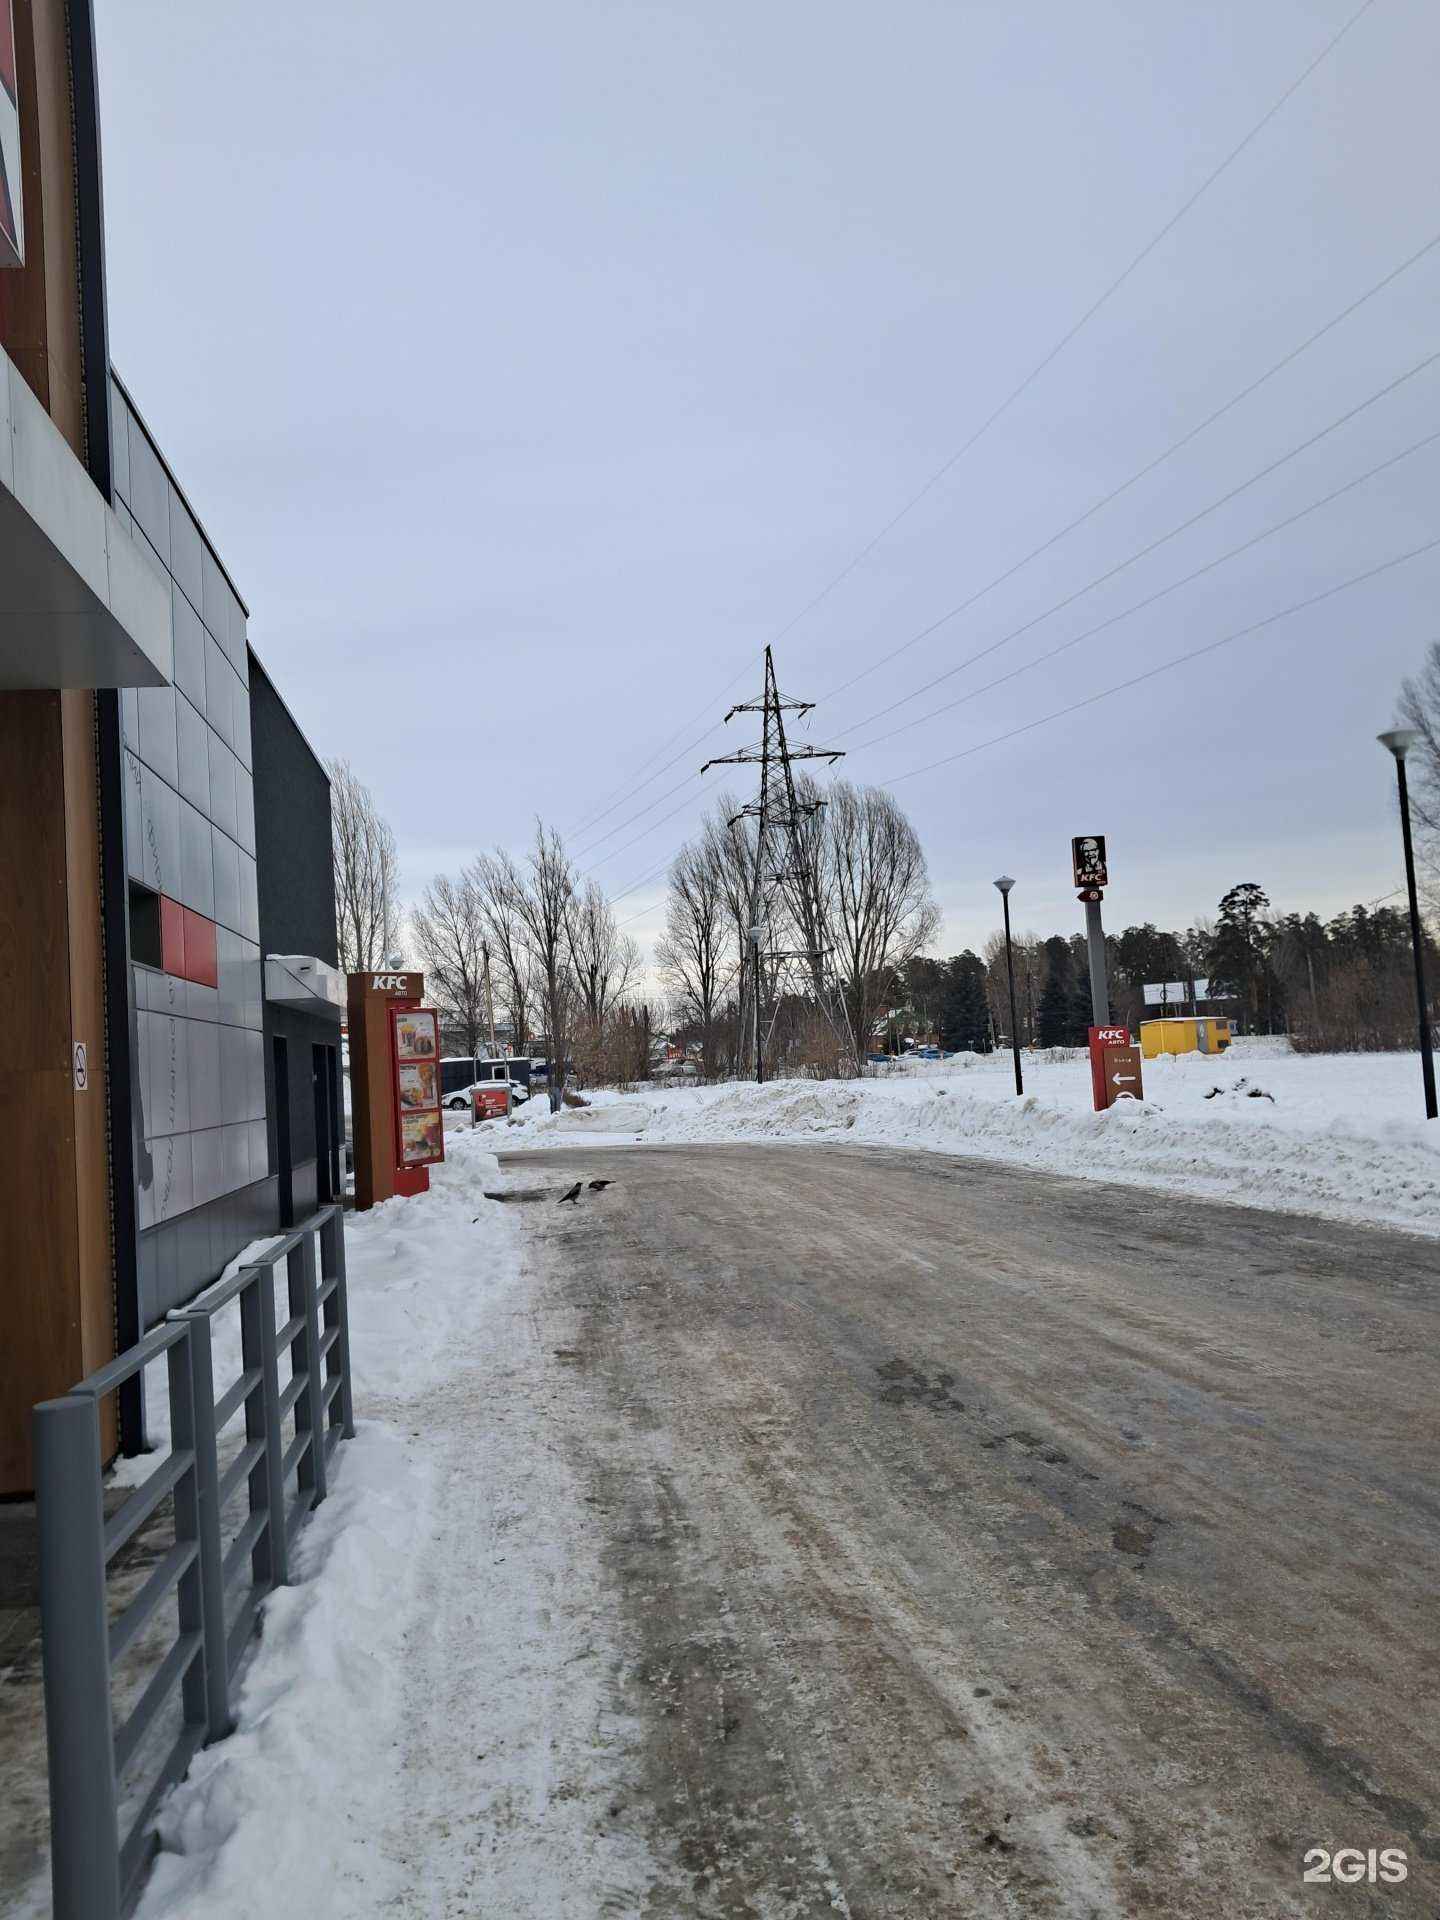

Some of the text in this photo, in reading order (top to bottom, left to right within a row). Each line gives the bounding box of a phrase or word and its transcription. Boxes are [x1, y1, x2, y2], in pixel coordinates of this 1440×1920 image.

[1080, 873, 1102, 882] KFC
[372, 975, 407, 990] KFC
[1098, 1029, 1124, 1040] KFC
